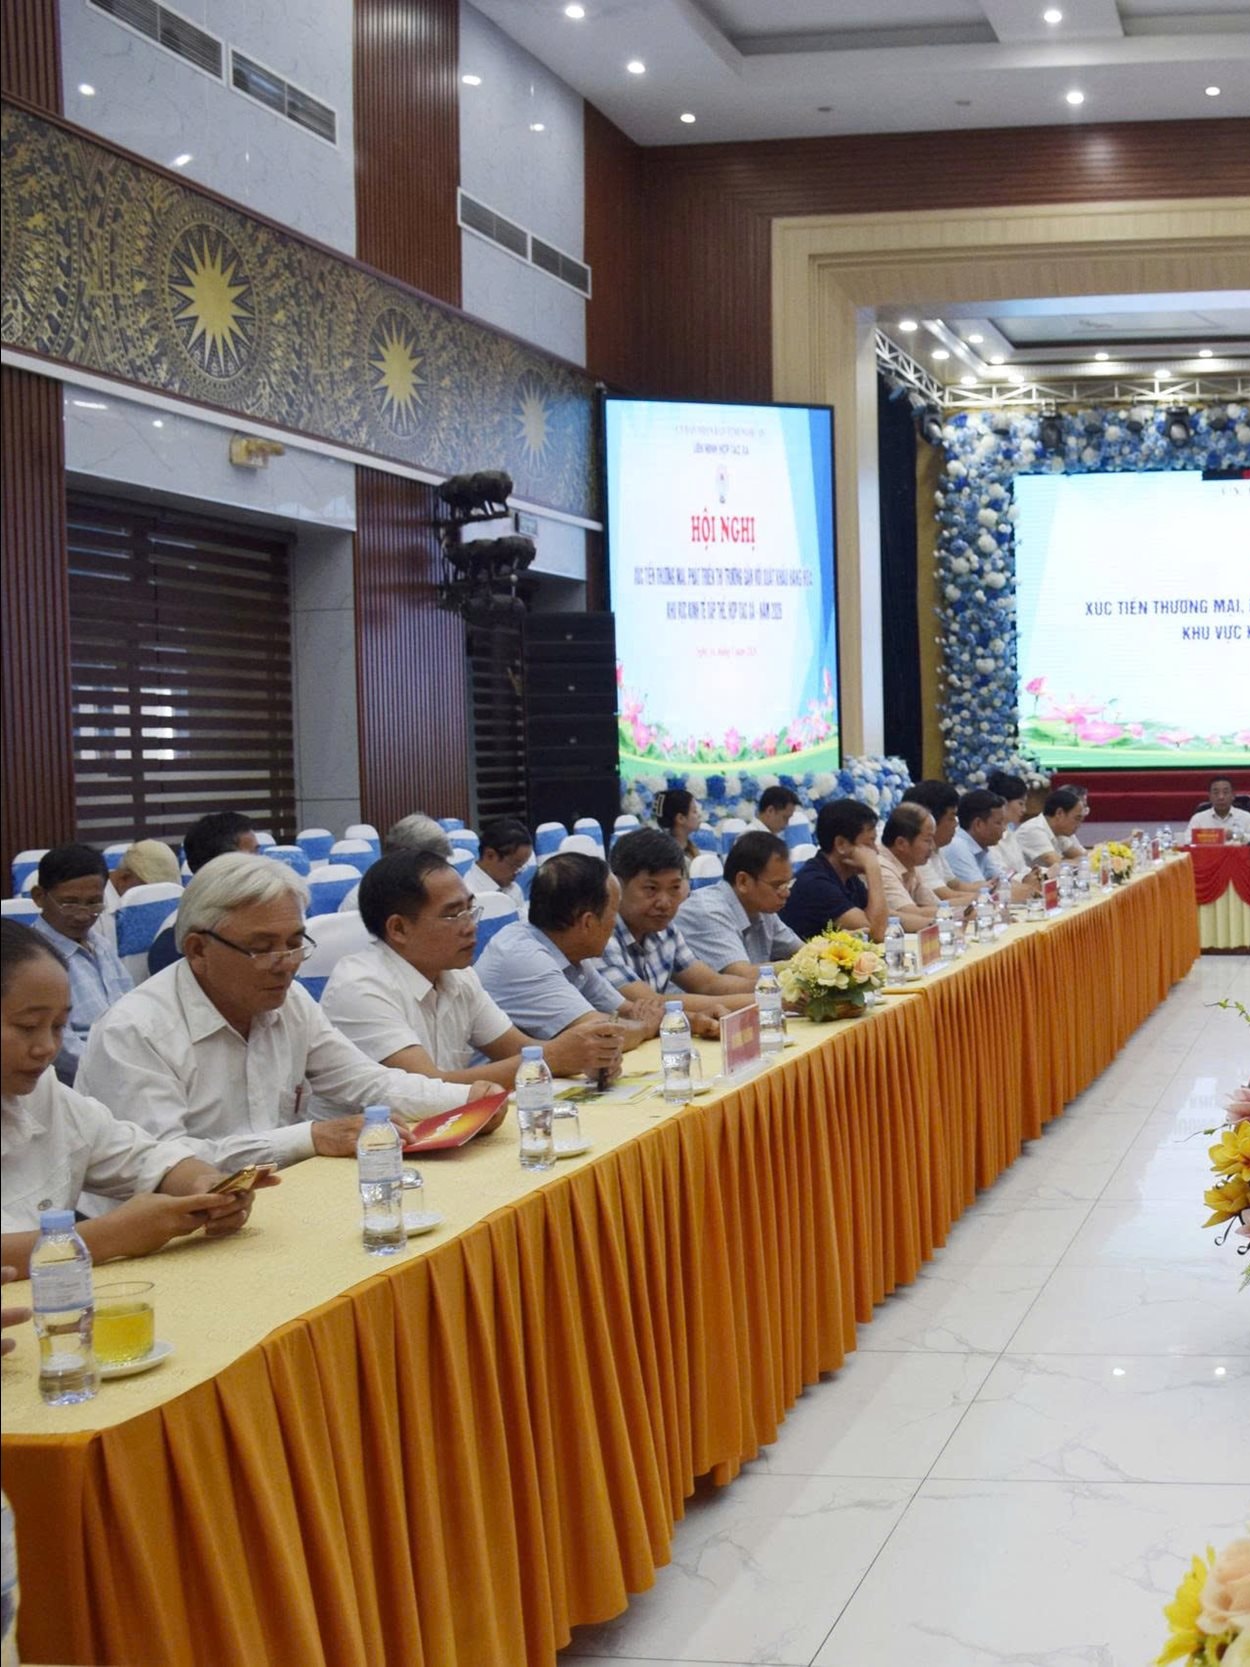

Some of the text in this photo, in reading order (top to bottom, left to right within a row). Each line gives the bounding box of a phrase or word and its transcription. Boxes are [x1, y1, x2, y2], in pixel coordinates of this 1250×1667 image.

[691, 507, 756, 551] HỘI NGHỊ
[1181, 625, 1211, 640] KHU
